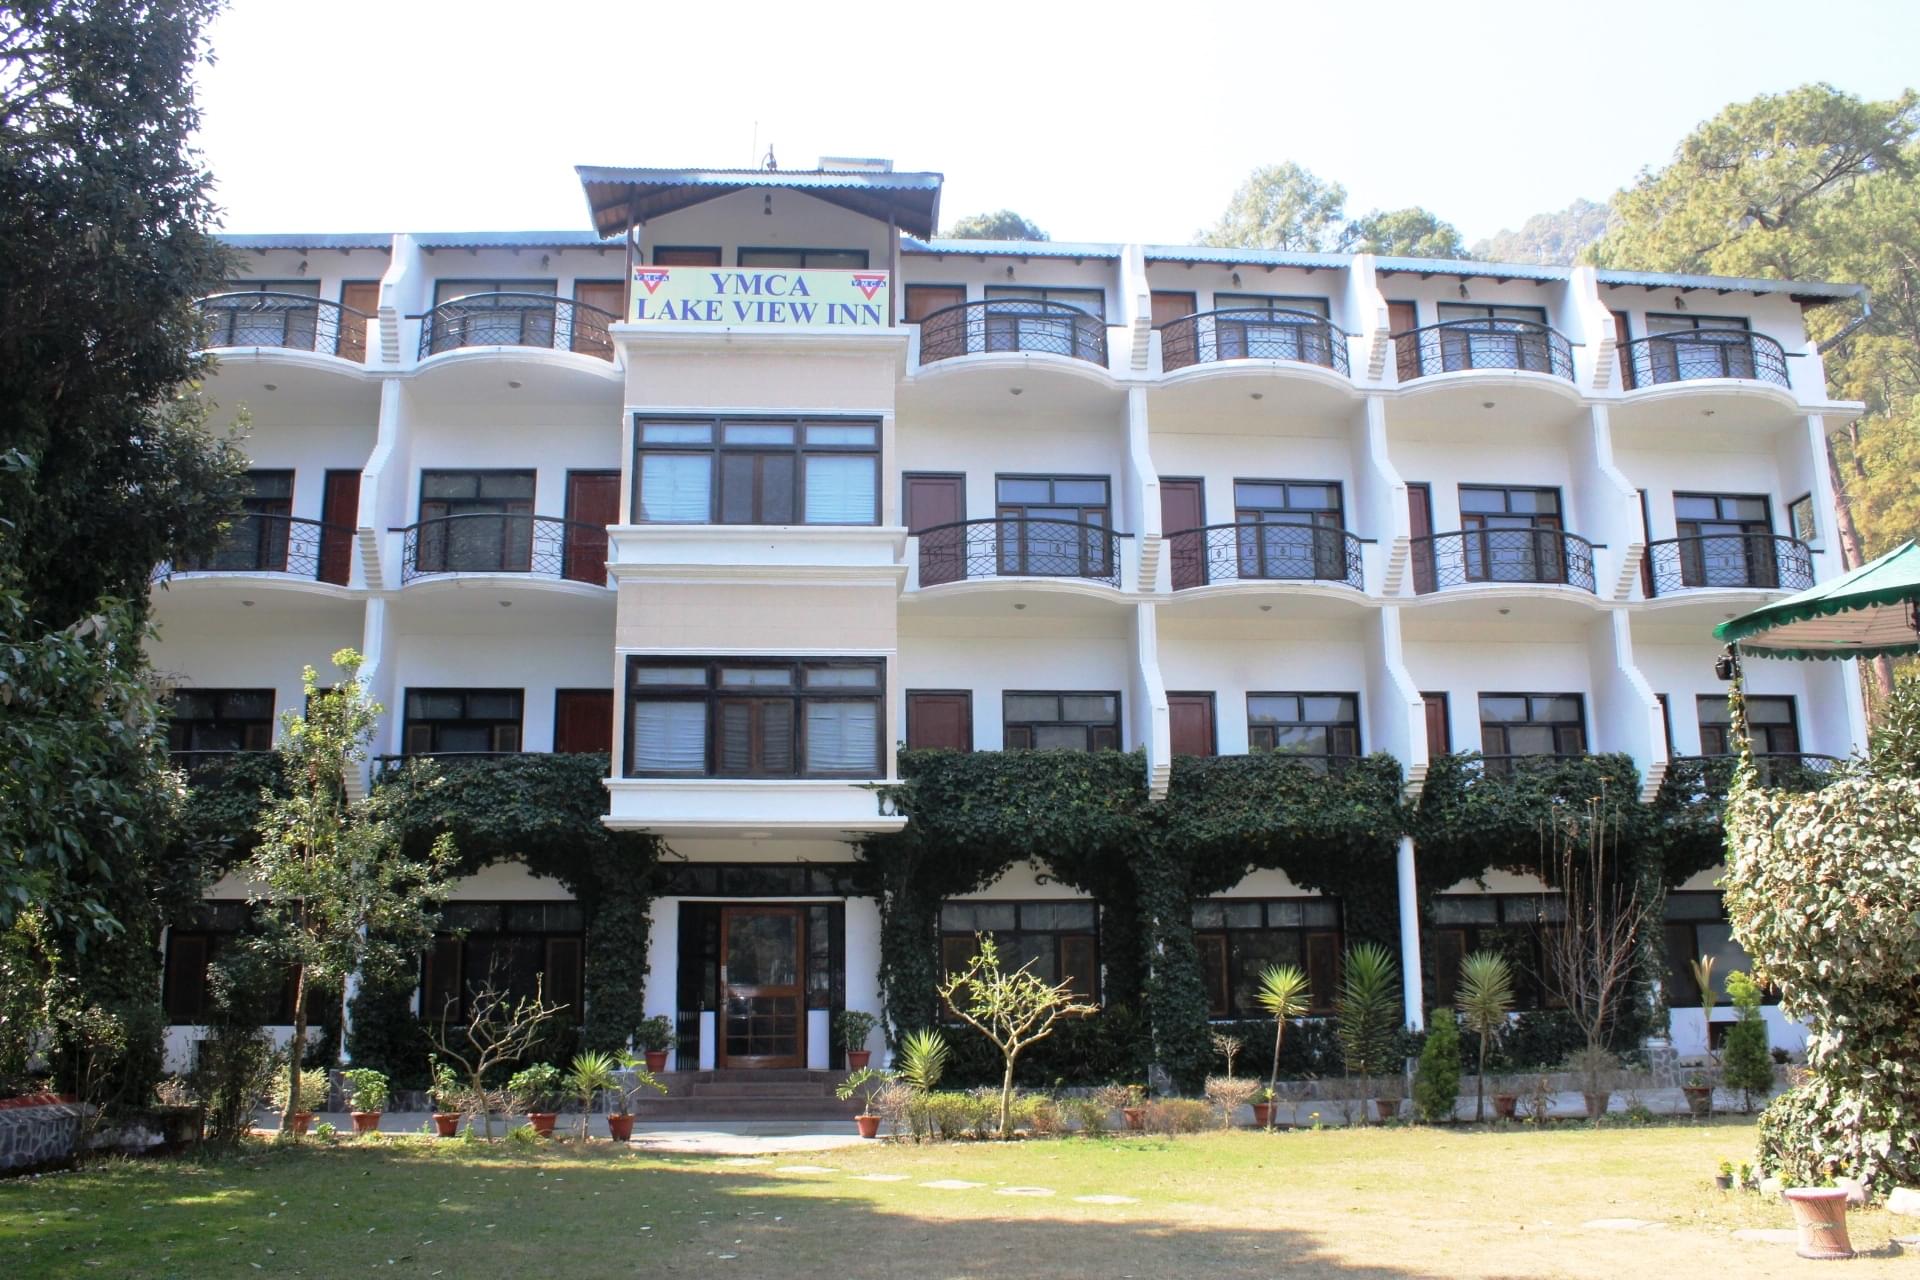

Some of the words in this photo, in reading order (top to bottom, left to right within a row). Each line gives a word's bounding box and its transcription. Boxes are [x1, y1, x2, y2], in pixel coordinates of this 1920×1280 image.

[711, 273, 810, 297] YMCA
[637, 298, 723, 321] LAKE
[732, 301, 818, 324] VIEW
[826, 303, 881, 326] INN
